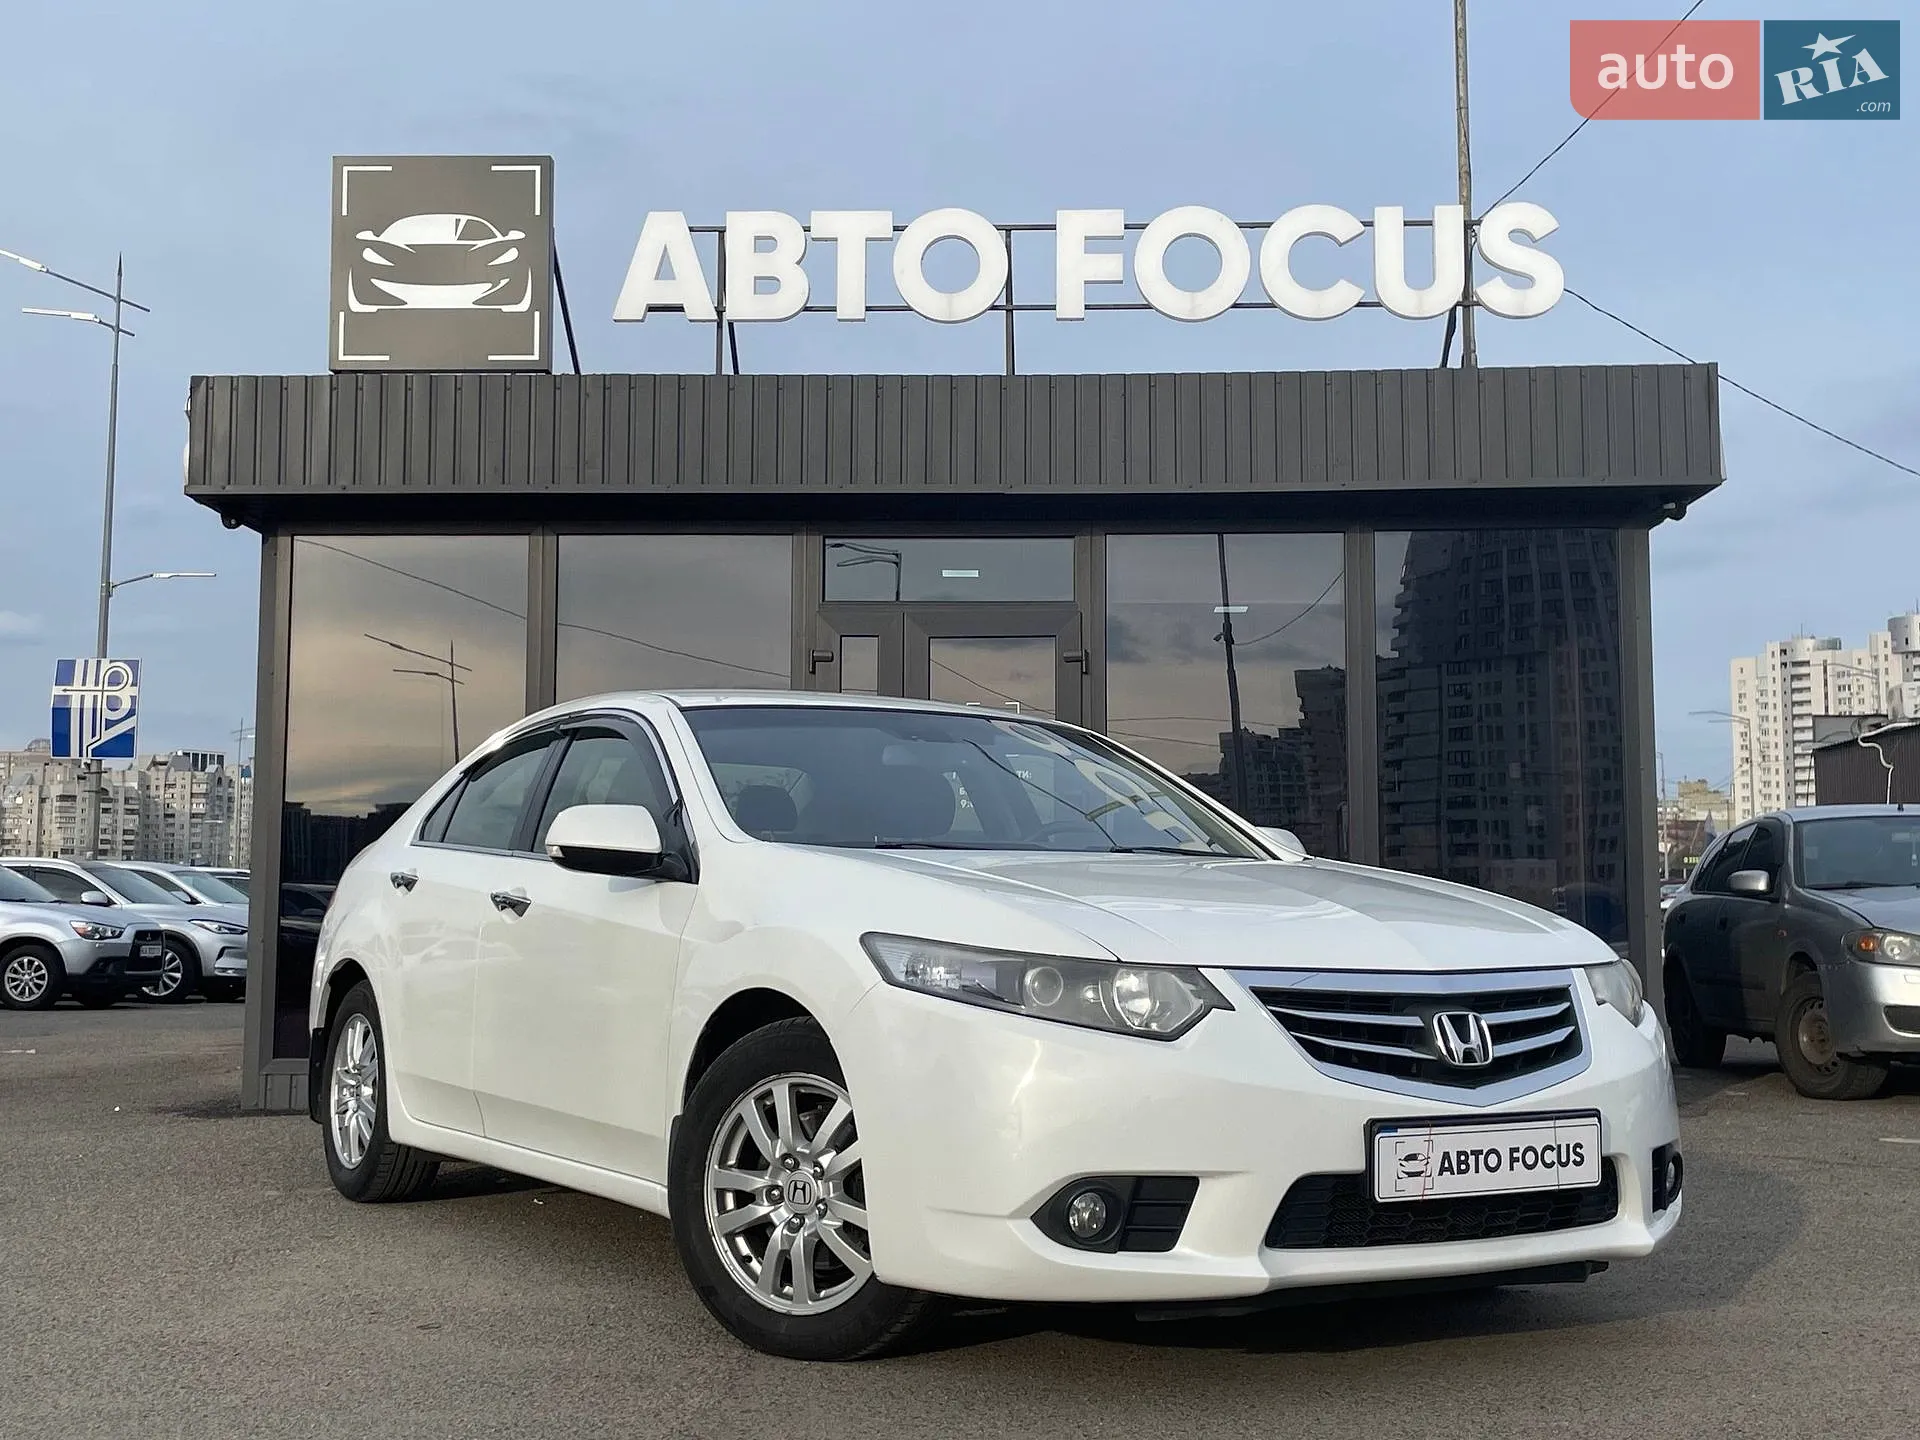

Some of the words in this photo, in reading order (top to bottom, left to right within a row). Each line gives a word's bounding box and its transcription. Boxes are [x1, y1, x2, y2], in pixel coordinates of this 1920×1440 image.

[612, 207, 1009, 323] АВТО
[1056, 202, 1565, 322] FOCUS
[1437, 1147, 1502, 1177] АВТО
[1509, 1142, 1585, 1172] FOCUS
